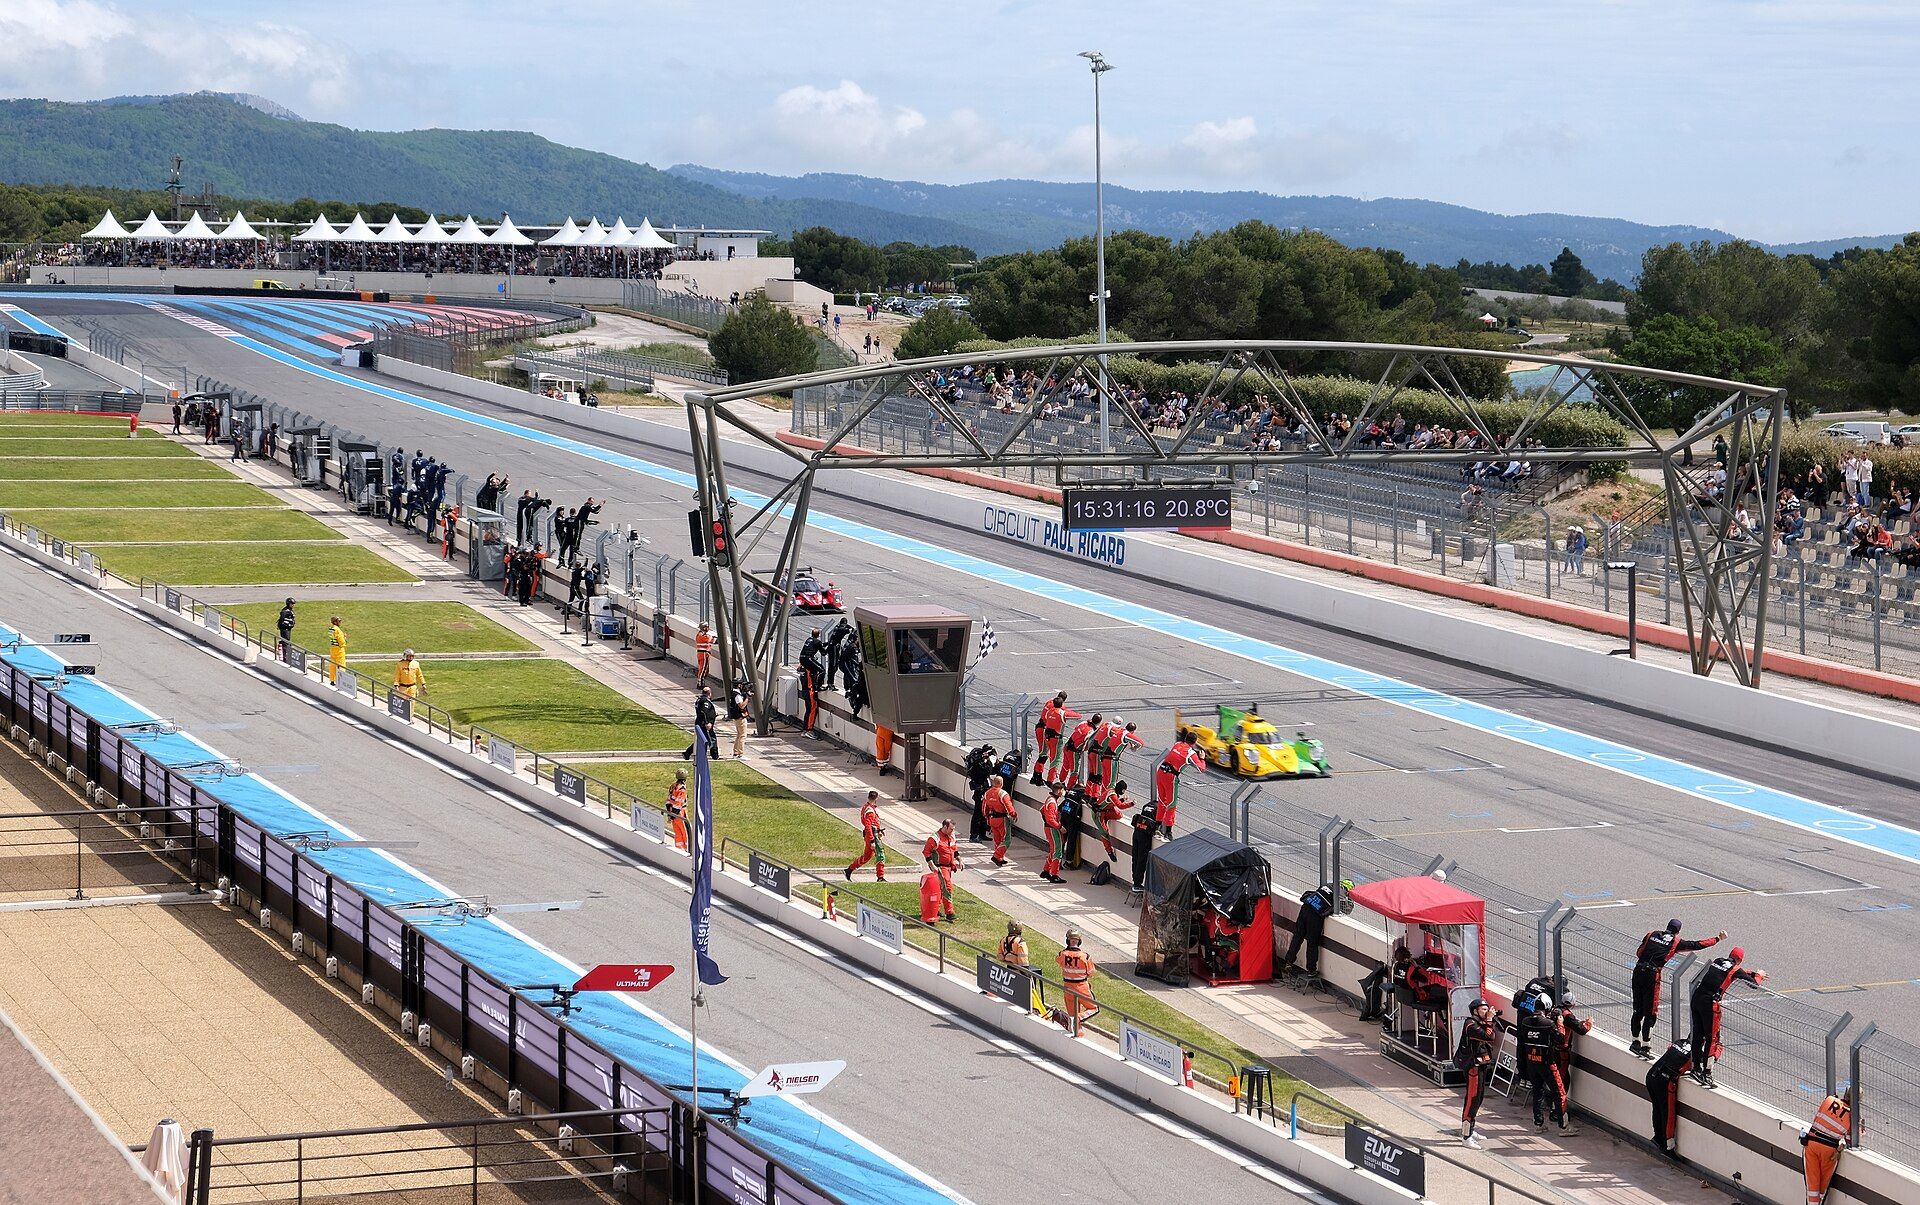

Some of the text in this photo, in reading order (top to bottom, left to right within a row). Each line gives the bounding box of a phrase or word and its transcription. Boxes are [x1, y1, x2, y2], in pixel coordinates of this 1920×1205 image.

[1073, 500, 1155, 518] 15:31:16
[984, 506, 1126, 566] CIRCUIT PAUL RICARD
[1064, 955, 1080, 967] RT
[1139, 1048, 1172, 1069] PAUL RICARD
[1502, 1054, 1512, 1067] 35
[786, 1075, 819, 1084] NIELSEN
[1828, 1100, 1851, 1119] RT
[1364, 1136, 1404, 1163] ELMS
